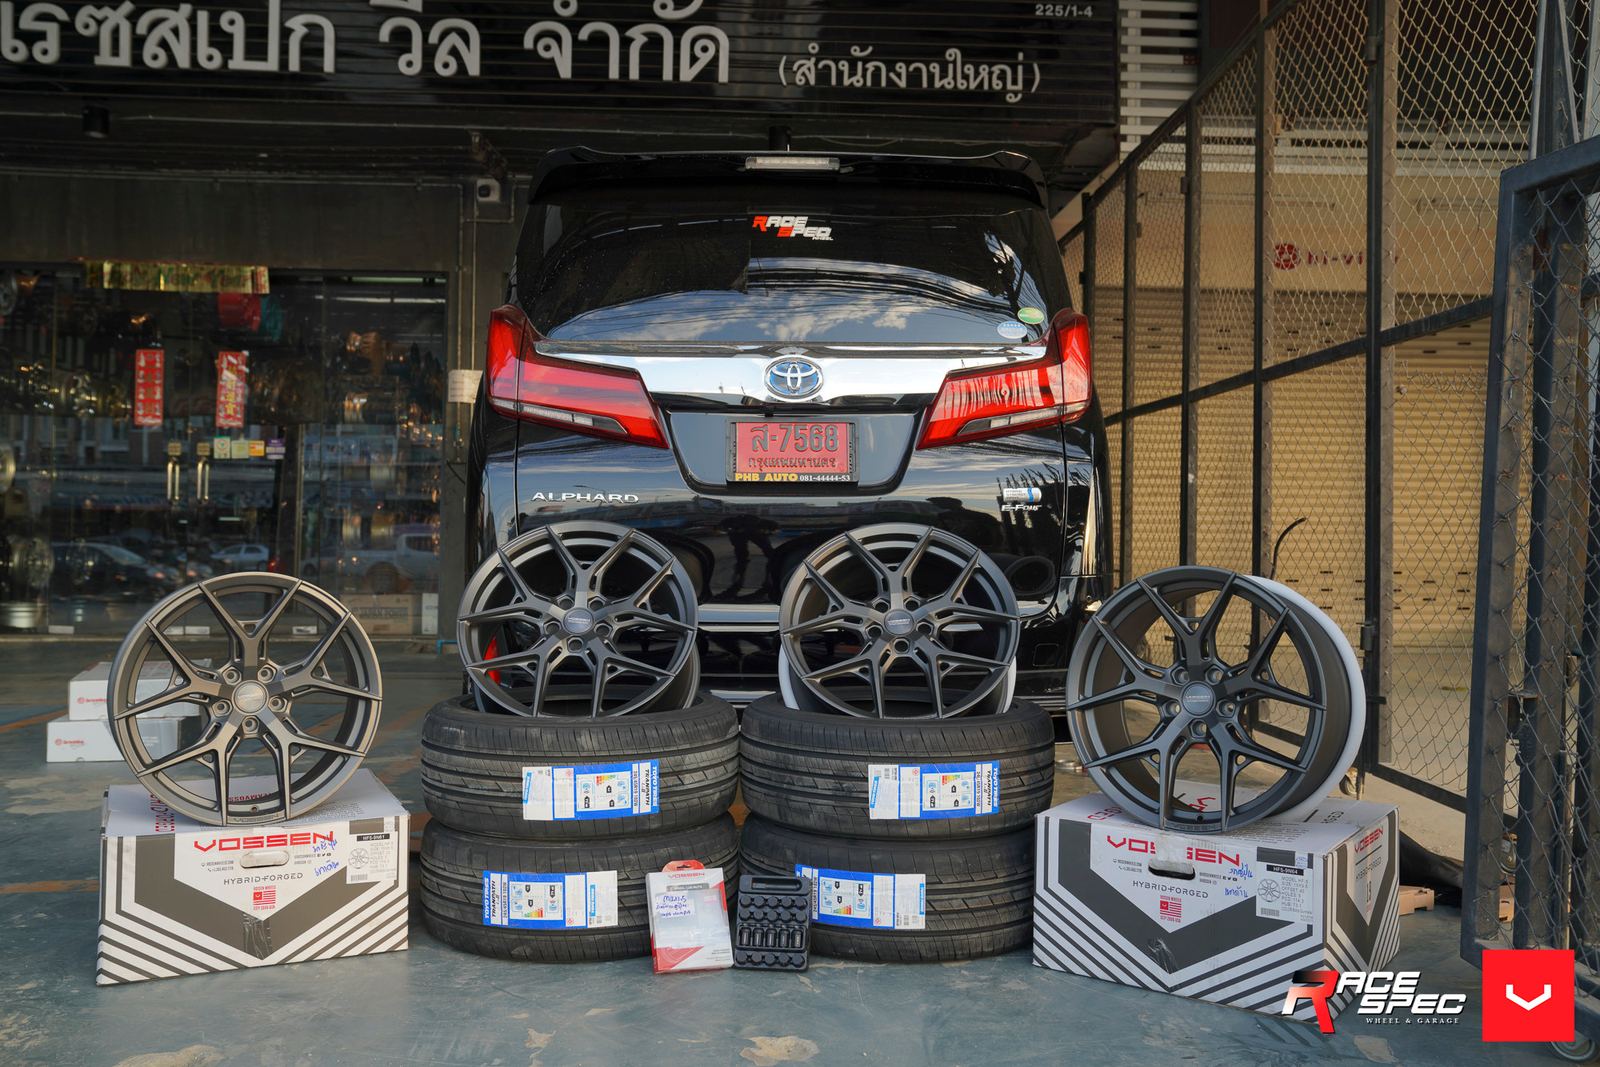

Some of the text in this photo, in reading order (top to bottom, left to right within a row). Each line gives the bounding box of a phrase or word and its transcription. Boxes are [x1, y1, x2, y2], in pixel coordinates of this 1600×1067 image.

[1035, 3, 1093, 18] 225/1-4
[752, 215, 808, 232] RACE
[777, 226, 832, 238] SPEC
[735, 473, 760, 481] PHB
[763, 473, 798, 481] AUTO
[531, 492, 639, 504] ALPHARD
[193, 830, 334, 853] VOSSEN
[1354, 825, 1384, 853] VOSSEN
